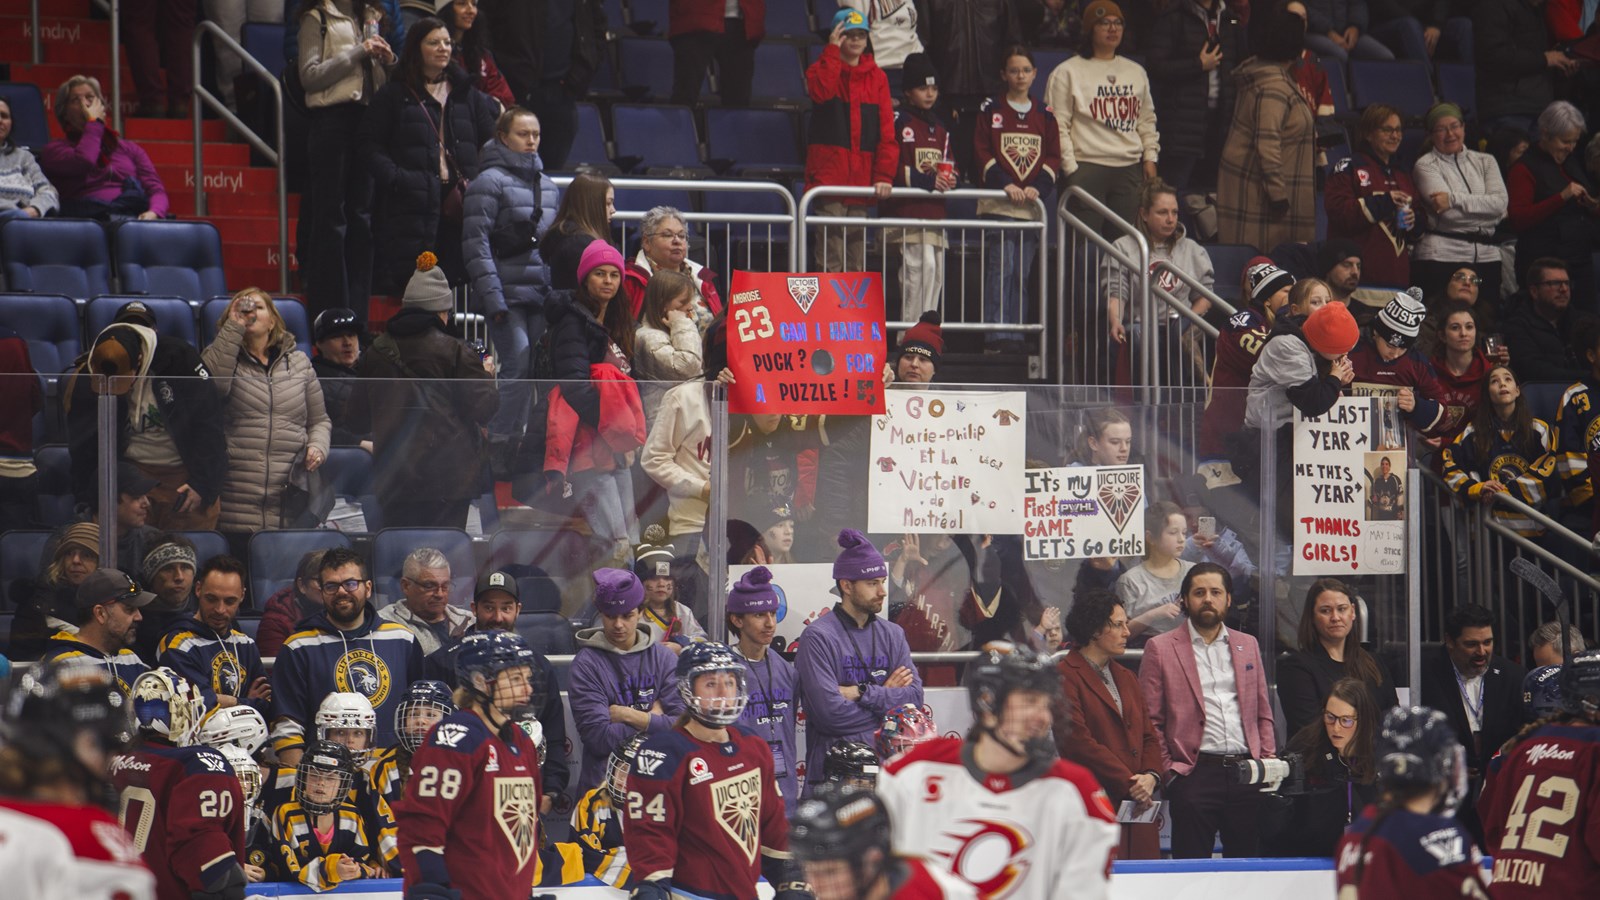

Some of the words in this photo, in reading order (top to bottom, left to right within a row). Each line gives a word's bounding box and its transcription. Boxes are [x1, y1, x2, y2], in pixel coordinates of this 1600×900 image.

[23, 21, 81, 43] kndryl
[1097, 84, 1134, 97] ALLEZ!
[1003, 135, 1040, 149] VICTOIRE
[185, 169, 243, 193] kndryl
[732, 289, 762, 305] AMBROSE
[1385, 300, 1426, 326] HUSKY
[735, 305, 775, 343] 23
[779, 322, 808, 342] CAN
[815, 322, 821, 342] I
[829, 321, 865, 342] HAVE
[871, 321, 882, 341] A
[845, 353, 875, 373] FOR
[755, 383, 767, 403] A
[905, 396, 945, 419] GO
[1328, 405, 1369, 424] LAST
[1308, 429, 1351, 451] YEAR
[898, 469, 971, 491] Victoire
[1296, 463, 1313, 477] ME
[1316, 464, 1353, 482] THIS
[1024, 470, 1060, 494] It's
[1067, 475, 1092, 499] my
[1311, 484, 1355, 504] YEAR
[929, 494, 945, 507] de
[903, 507, 963, 530] Montréal
[1024, 519, 1073, 537] GAME
[1300, 516, 1361, 537] THANKS
[1025, 537, 1075, 559] LET'S
[1302, 543, 1357, 562] GIRLS!
[640, 749, 667, 759] LPHF
[1526, 744, 1575, 765] Molson
[109, 755, 151, 776] Molson
[418, 766, 462, 800] 28
[715, 775, 759, 806] VICTOIRE
[199, 789, 233, 818] 20
[627, 791, 666, 822] 24
[1501, 775, 1580, 859] 42
